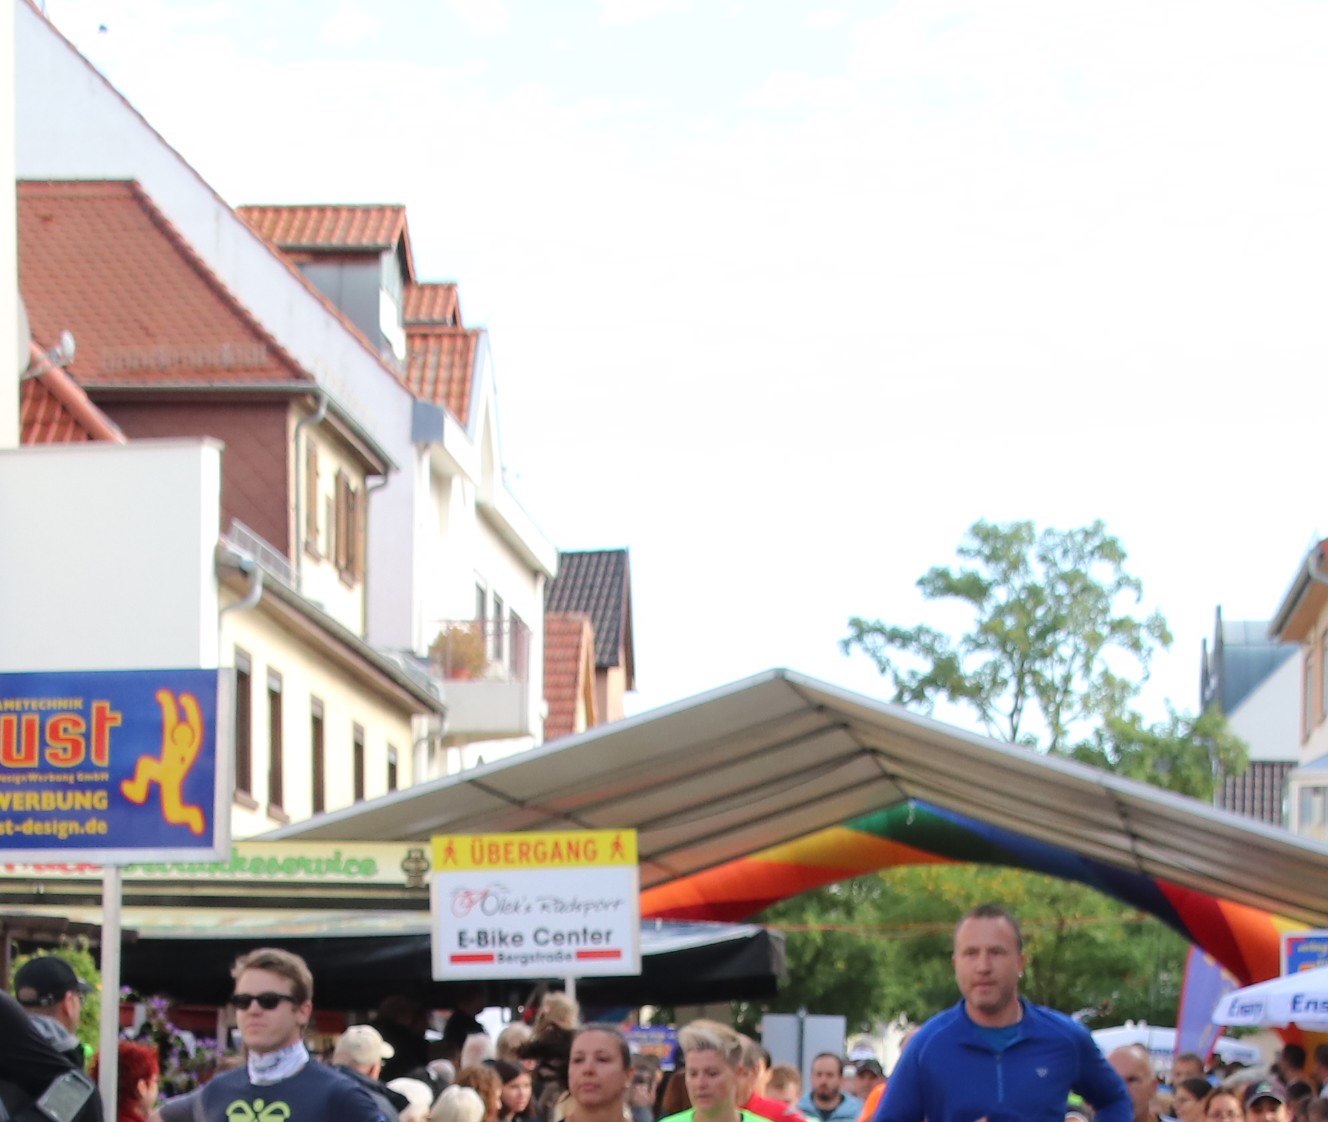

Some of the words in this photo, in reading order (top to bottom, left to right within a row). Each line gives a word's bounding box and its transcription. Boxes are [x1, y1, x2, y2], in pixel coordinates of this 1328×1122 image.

[471, 837, 598, 865] ÜBERGANG
[458, 929, 524, 947] E-Bike
[533, 927, 613, 946] Center
[497, 952, 573, 966] Bergstraße
